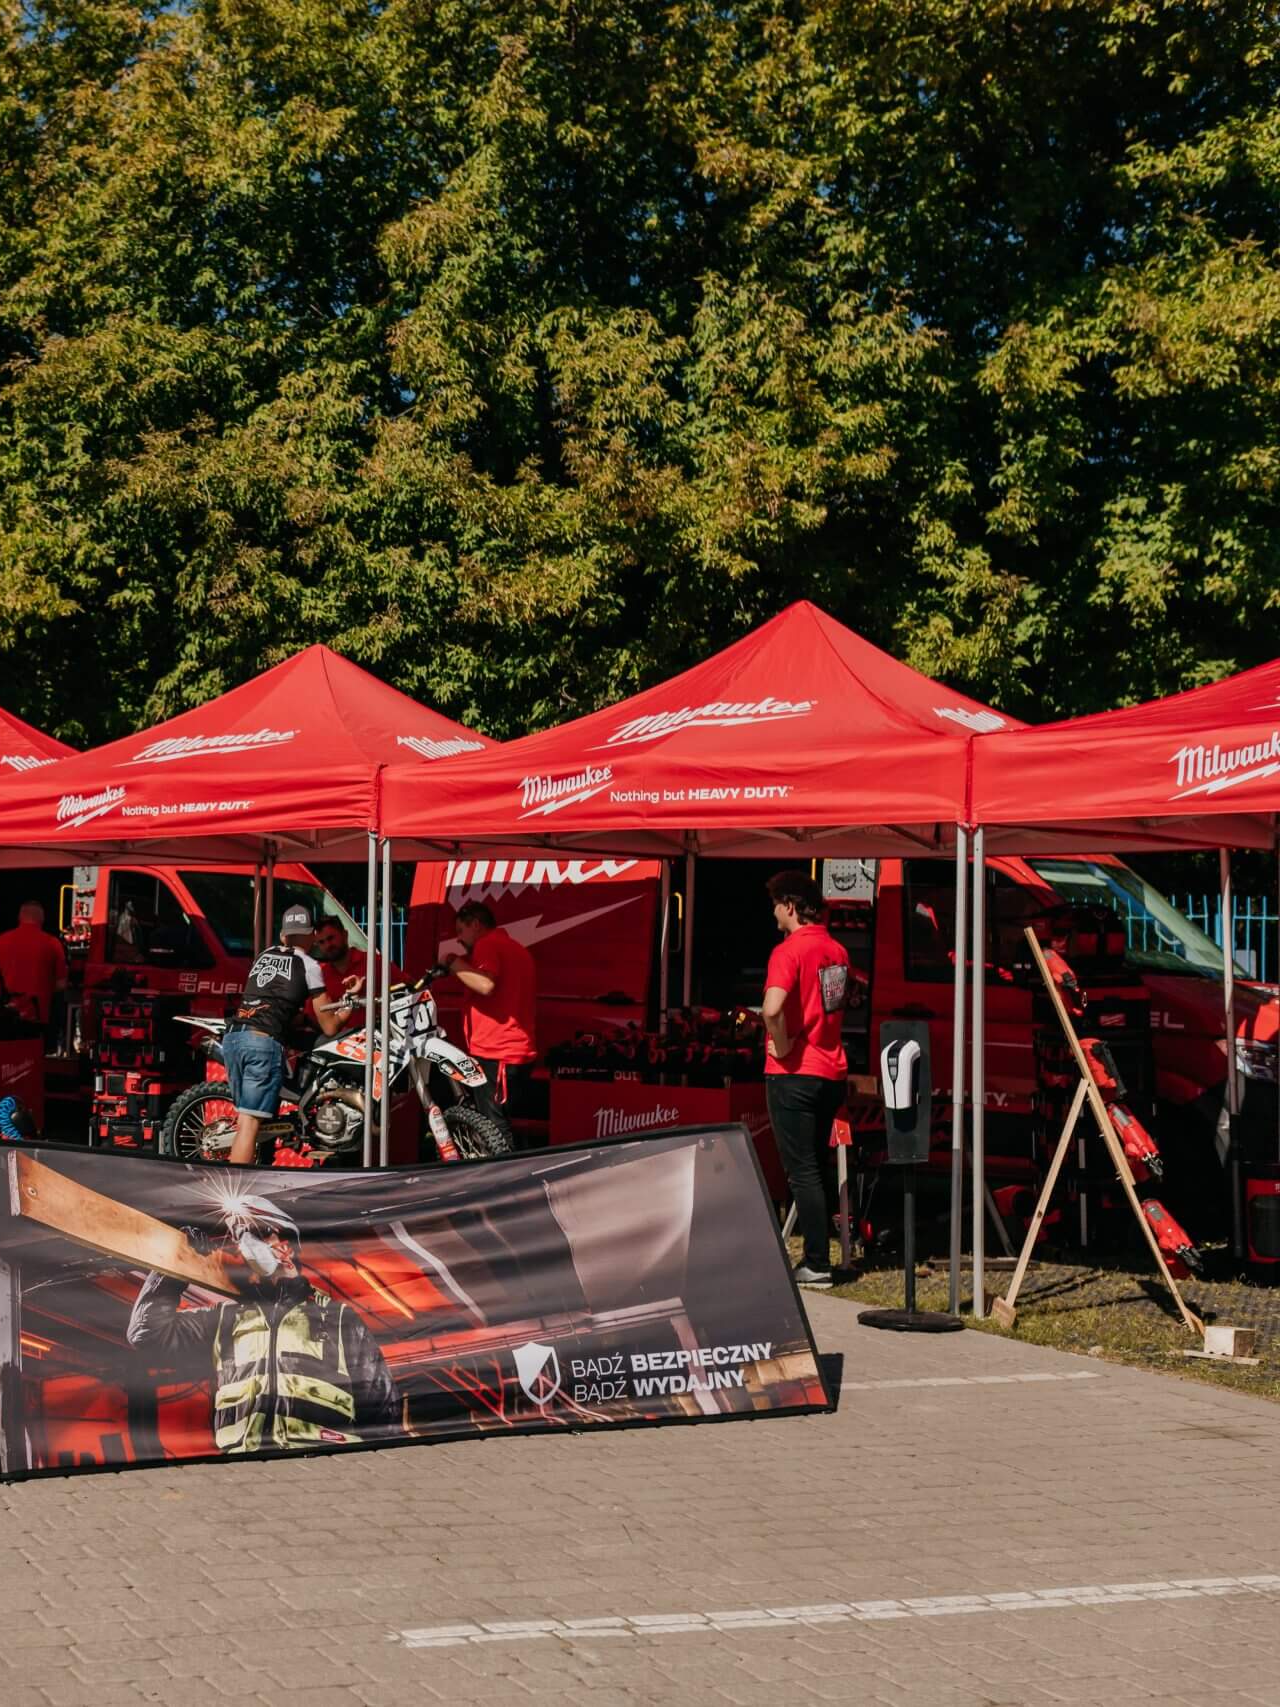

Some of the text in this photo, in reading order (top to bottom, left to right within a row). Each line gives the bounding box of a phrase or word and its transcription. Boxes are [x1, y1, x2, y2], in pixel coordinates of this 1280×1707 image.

[608, 697, 812, 743] Milwaukee
[133, 728, 295, 761] Milwaukee
[1168, 732, 1280, 787] Milwauk
[57, 785, 126, 821] Milwaukee
[518, 765, 613, 808] Milwaukee
[610, 790, 660, 804] Nothing
[664, 789, 685, 801] but
[688, 788, 740, 800] HEAVY
[122, 805, 160, 816] Nothing
[161, 804, 177, 814] but
[179, 802, 219, 813] HEAVY
[1149, 1010, 1185, 1029] EL
[593, 1103, 680, 1139] Milwaukee
[571, 1342, 772, 1380] BĄDŹ BEZPIECZNY
[573, 1369, 745, 1405] BĄDŹ WYDAJNY
